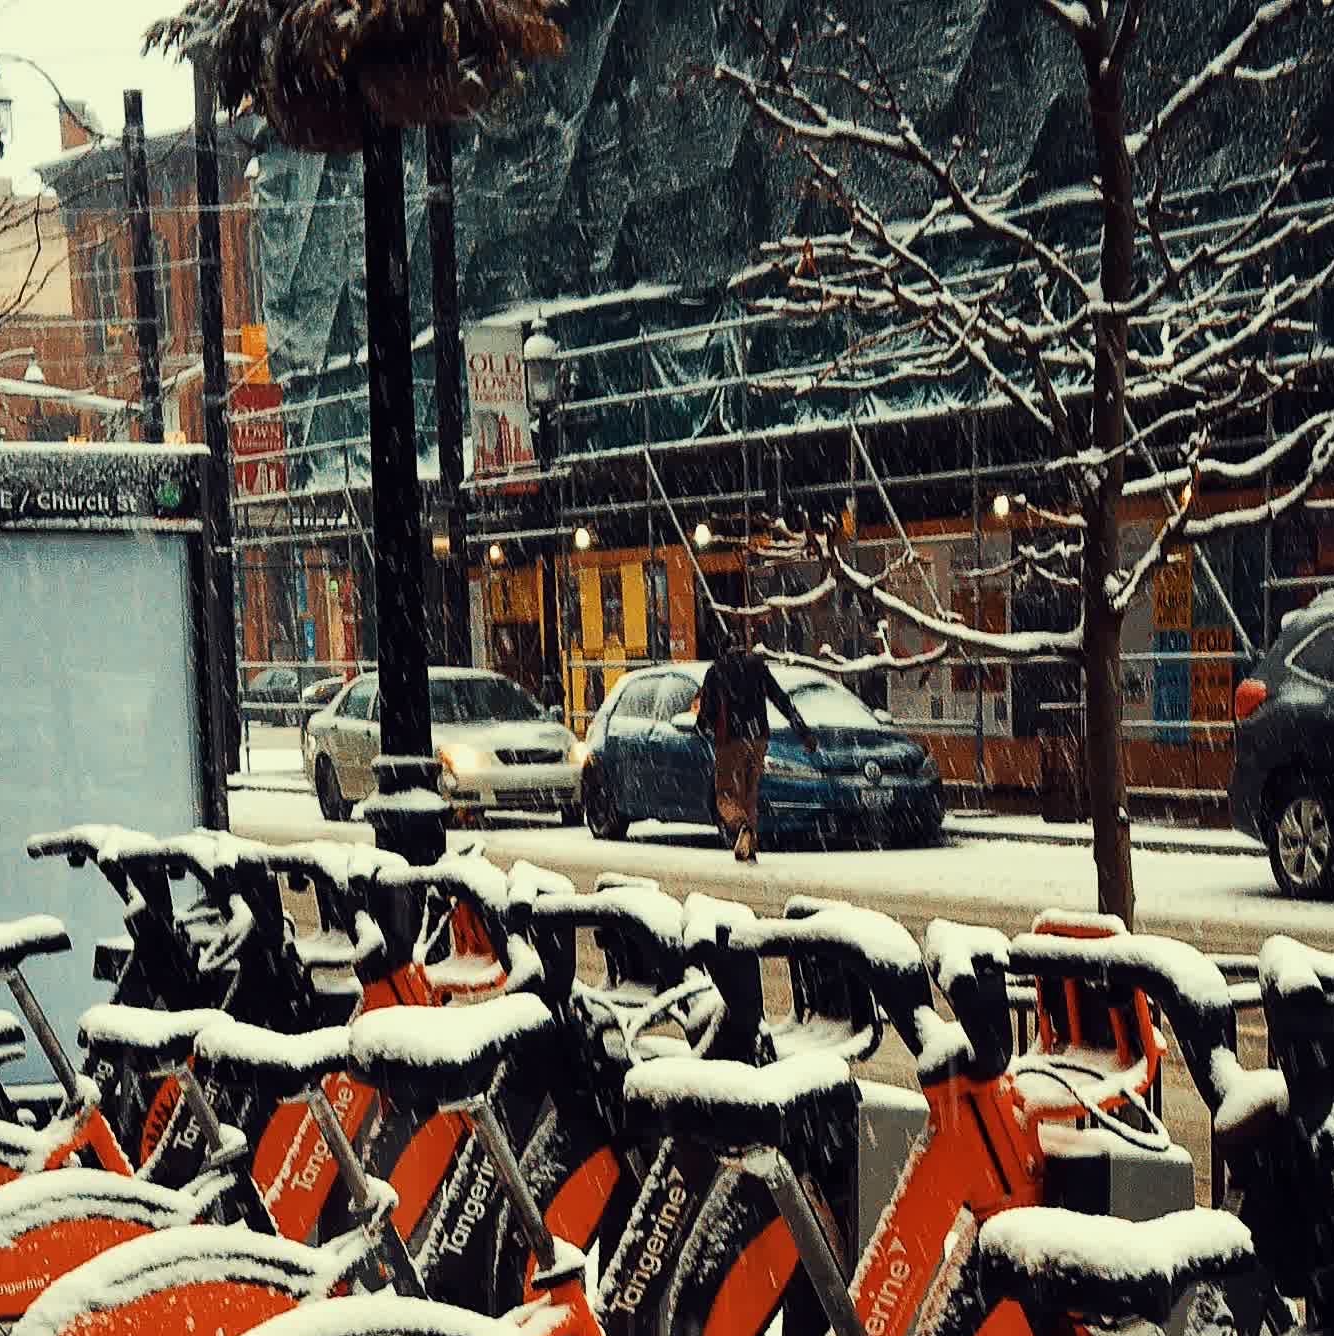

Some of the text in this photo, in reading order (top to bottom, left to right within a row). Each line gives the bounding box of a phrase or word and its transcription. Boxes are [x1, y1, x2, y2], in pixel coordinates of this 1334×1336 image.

[469, 352, 522, 374] OLD
[0, 488, 13, 509] E
[37, 490, 110, 512] Church
[116, 492, 139, 513] St
[609, 1186, 687, 1314] Tangerine
